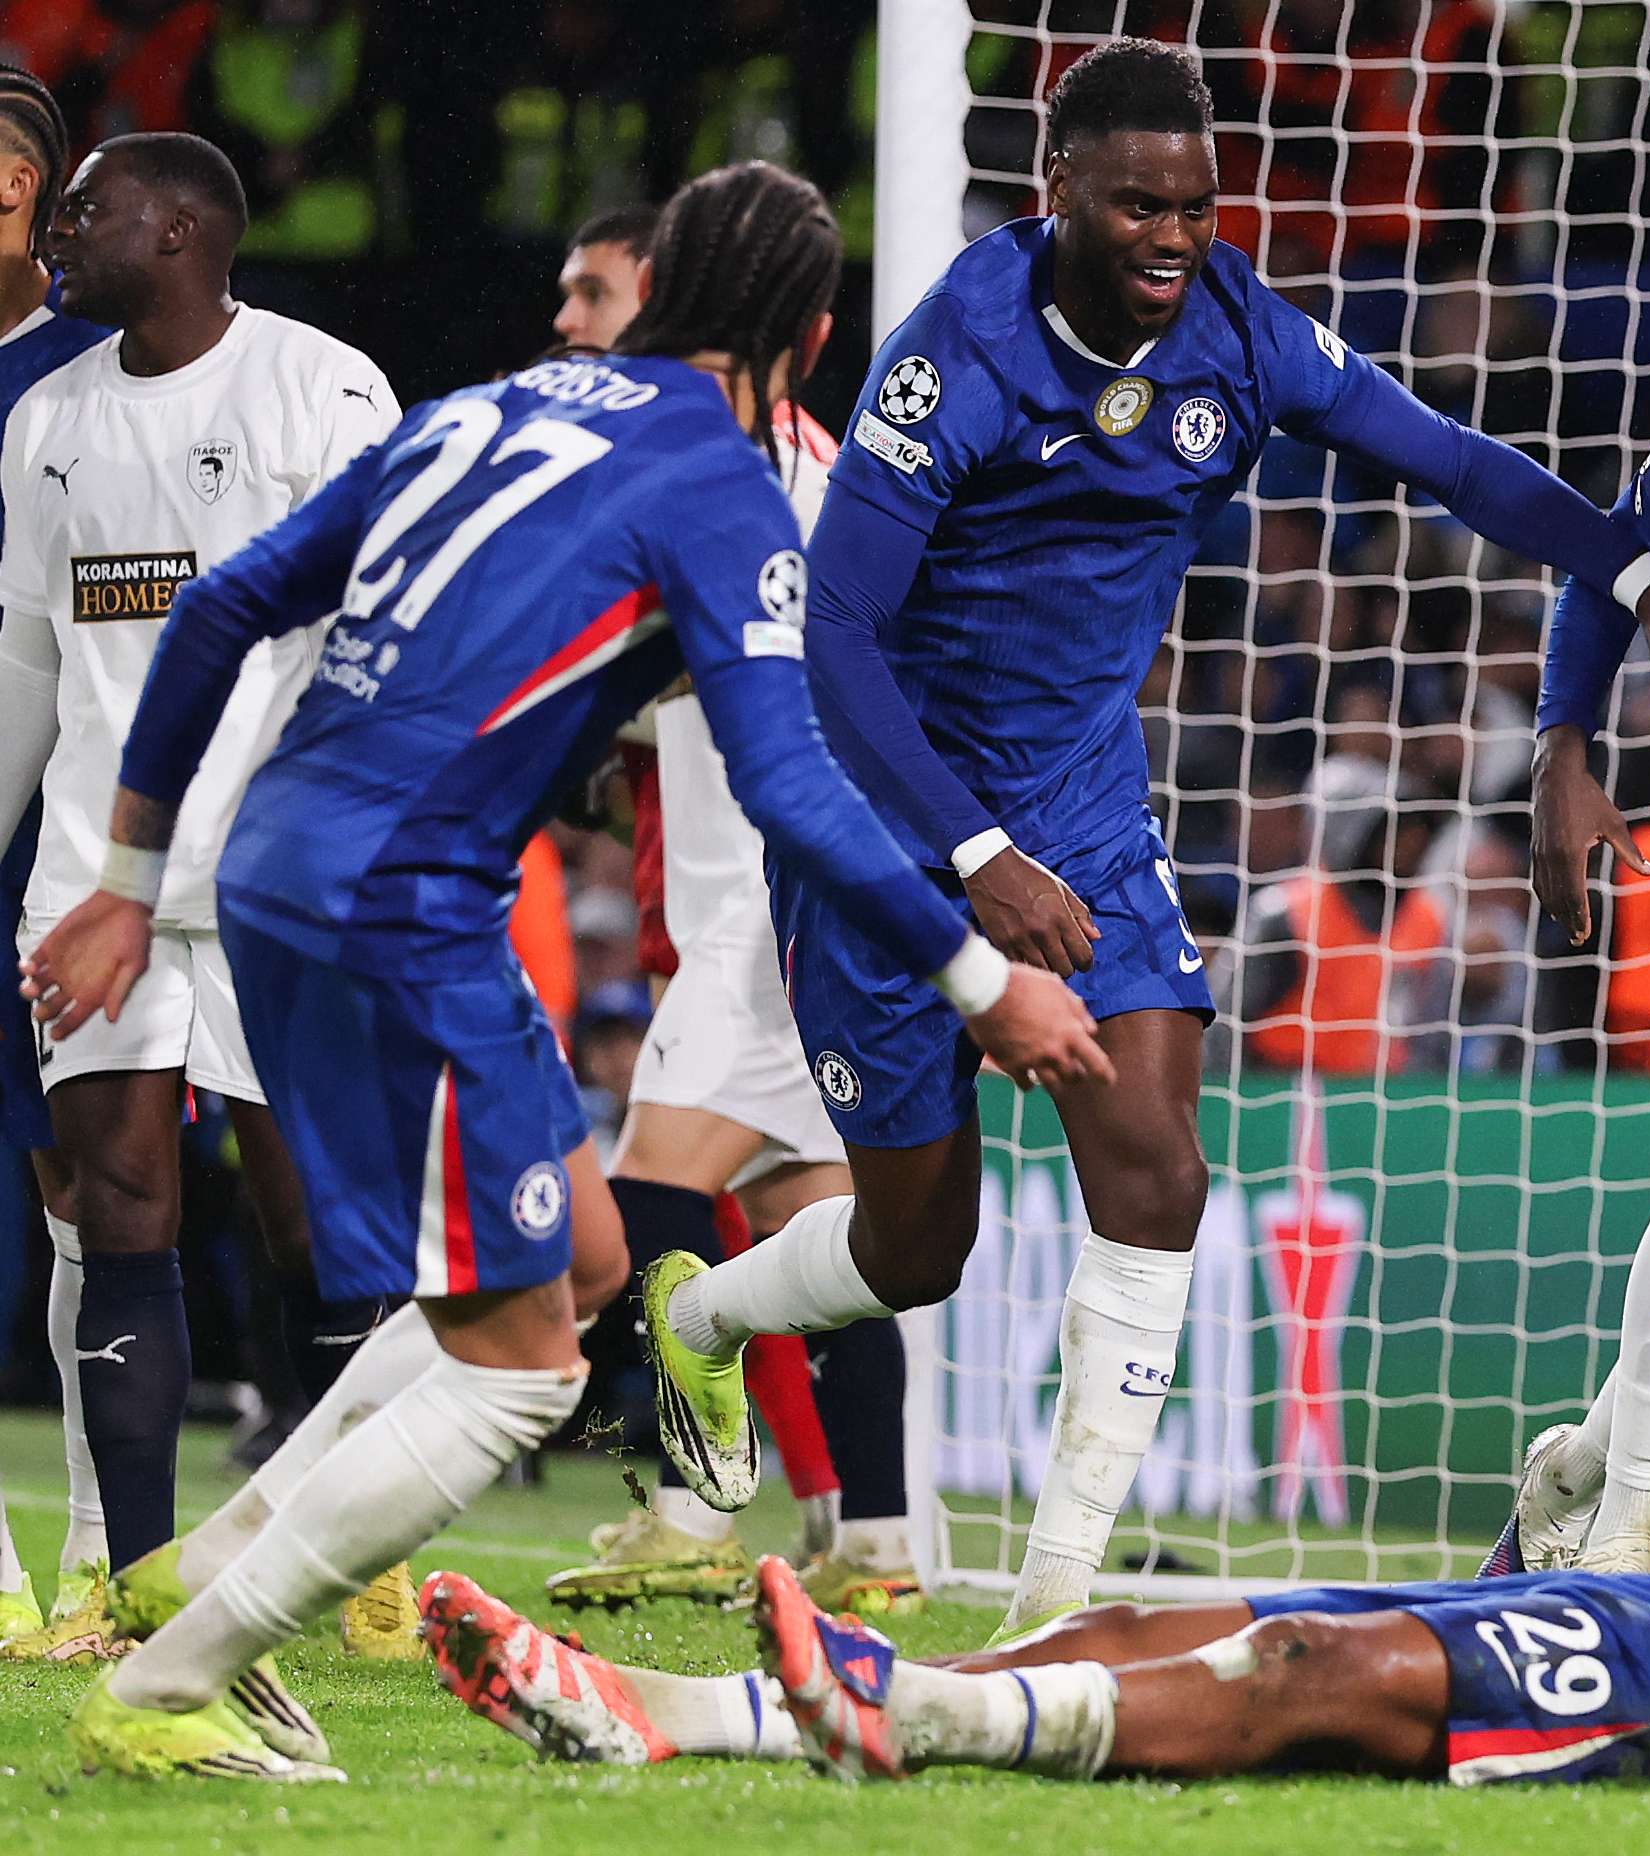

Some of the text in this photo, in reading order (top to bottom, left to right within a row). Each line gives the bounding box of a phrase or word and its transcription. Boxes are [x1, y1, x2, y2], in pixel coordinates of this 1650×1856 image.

[1179, 400, 1215, 417] CHELSEA
[1112, 418, 1133, 432] FIFA
[342, 398, 614, 630] 27
[76, 559, 193, 582] KORANTINA
[1125, 1361, 1170, 1387] CFC
[1500, 1607, 1612, 1716] 29
